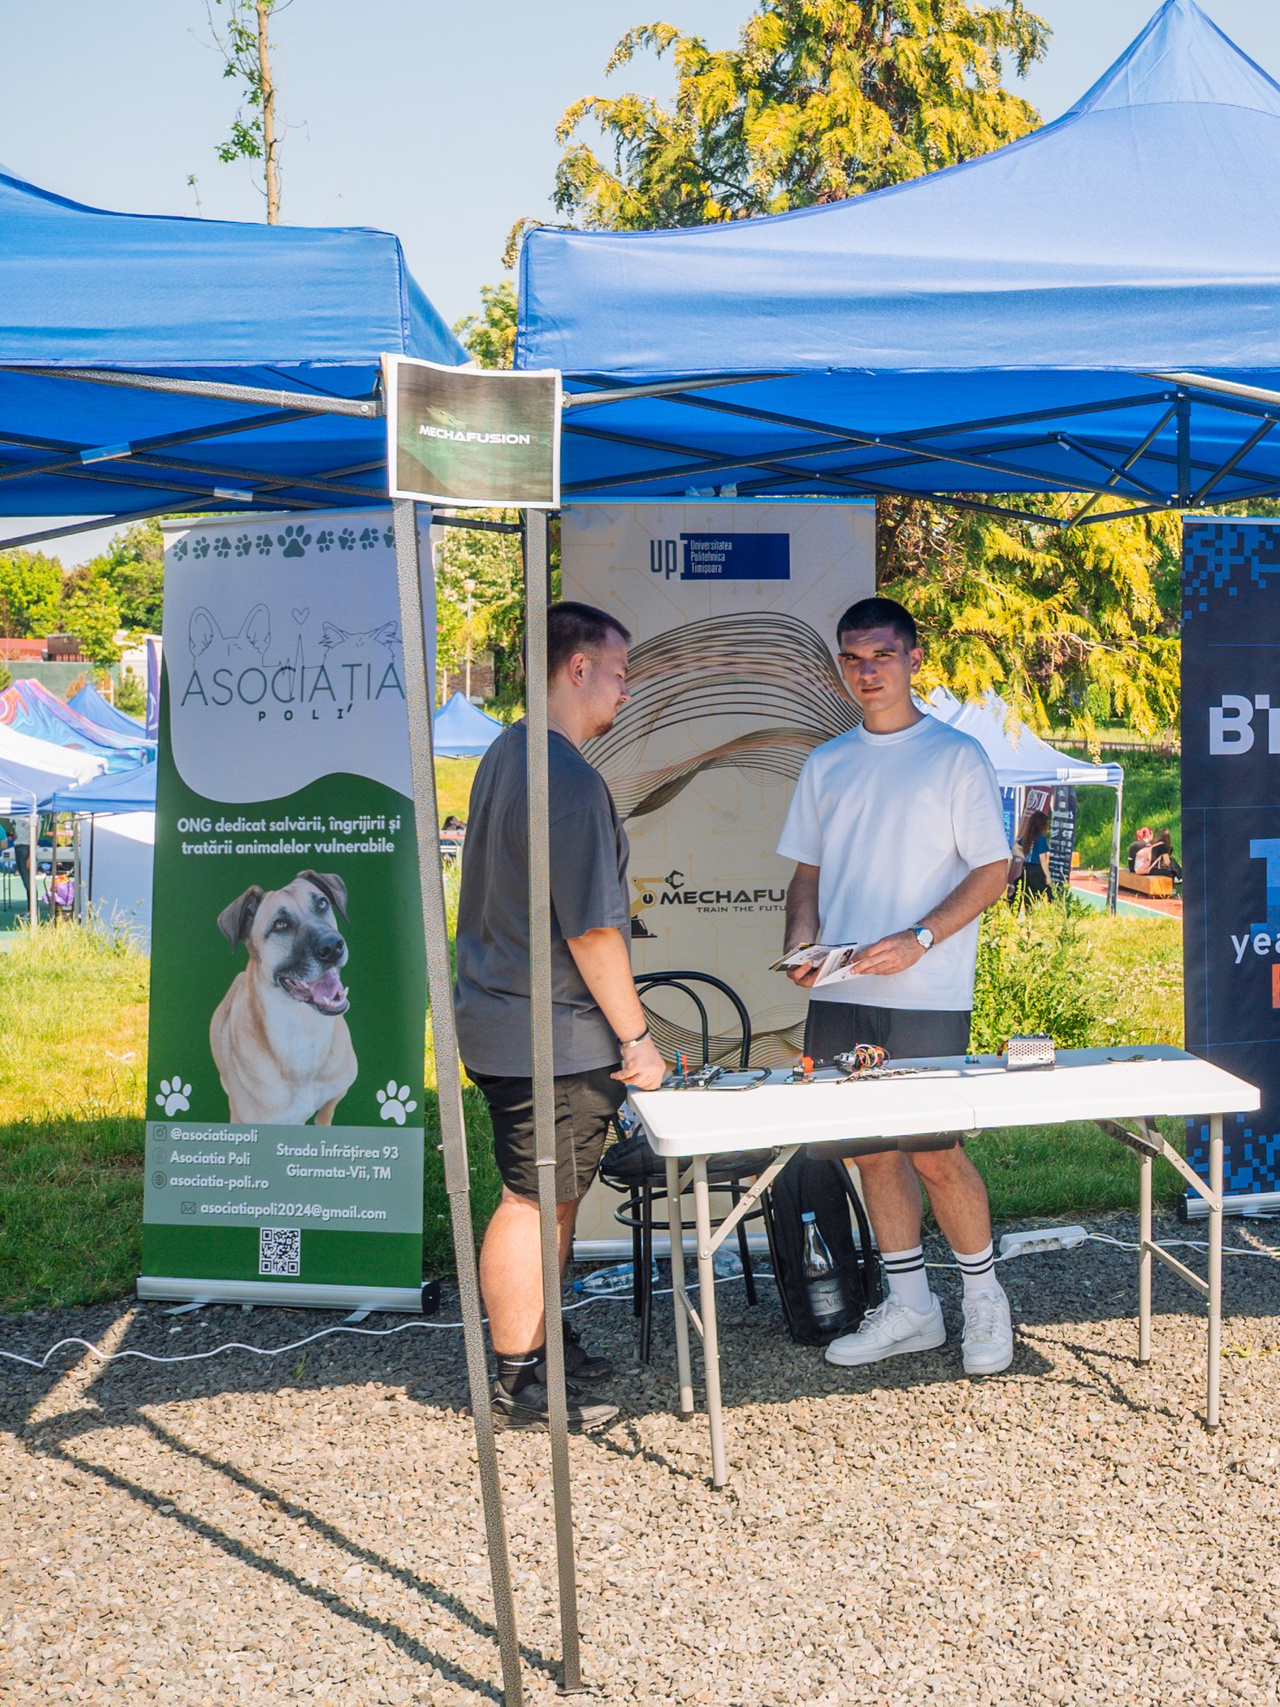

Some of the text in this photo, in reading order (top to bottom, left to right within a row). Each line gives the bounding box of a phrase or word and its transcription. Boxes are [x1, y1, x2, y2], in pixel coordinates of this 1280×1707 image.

[419, 424, 531, 445] MECHAFUSION
[690, 539, 733, 551] Universitatea
[690, 551, 726, 562] Politehnica
[691, 562, 723, 575] Timișoara
[258, 707, 344, 722] POLI
[177, 814, 401, 835] ONG dedicat salvării, îngrijirii și
[181, 837, 395, 855] tratării animalelor vulnerabile
[659, 888, 787, 906] MECHAFU
[696, 905, 729, 914] TRAIN
[732, 905, 755, 913] THE
[170, 1127, 260, 1146] @asociatiapoli
[169, 1150, 252, 1166] Asociatia Poli
[276, 1139, 400, 1163] Strada Înfrățirea 93
[286, 1163, 393, 1182] Giarmata-Vii, TM
[169, 1174, 270, 1191] asociatia-poli.ro
[200, 1200, 388, 1222] asociatiapoli2024@gmail.com
